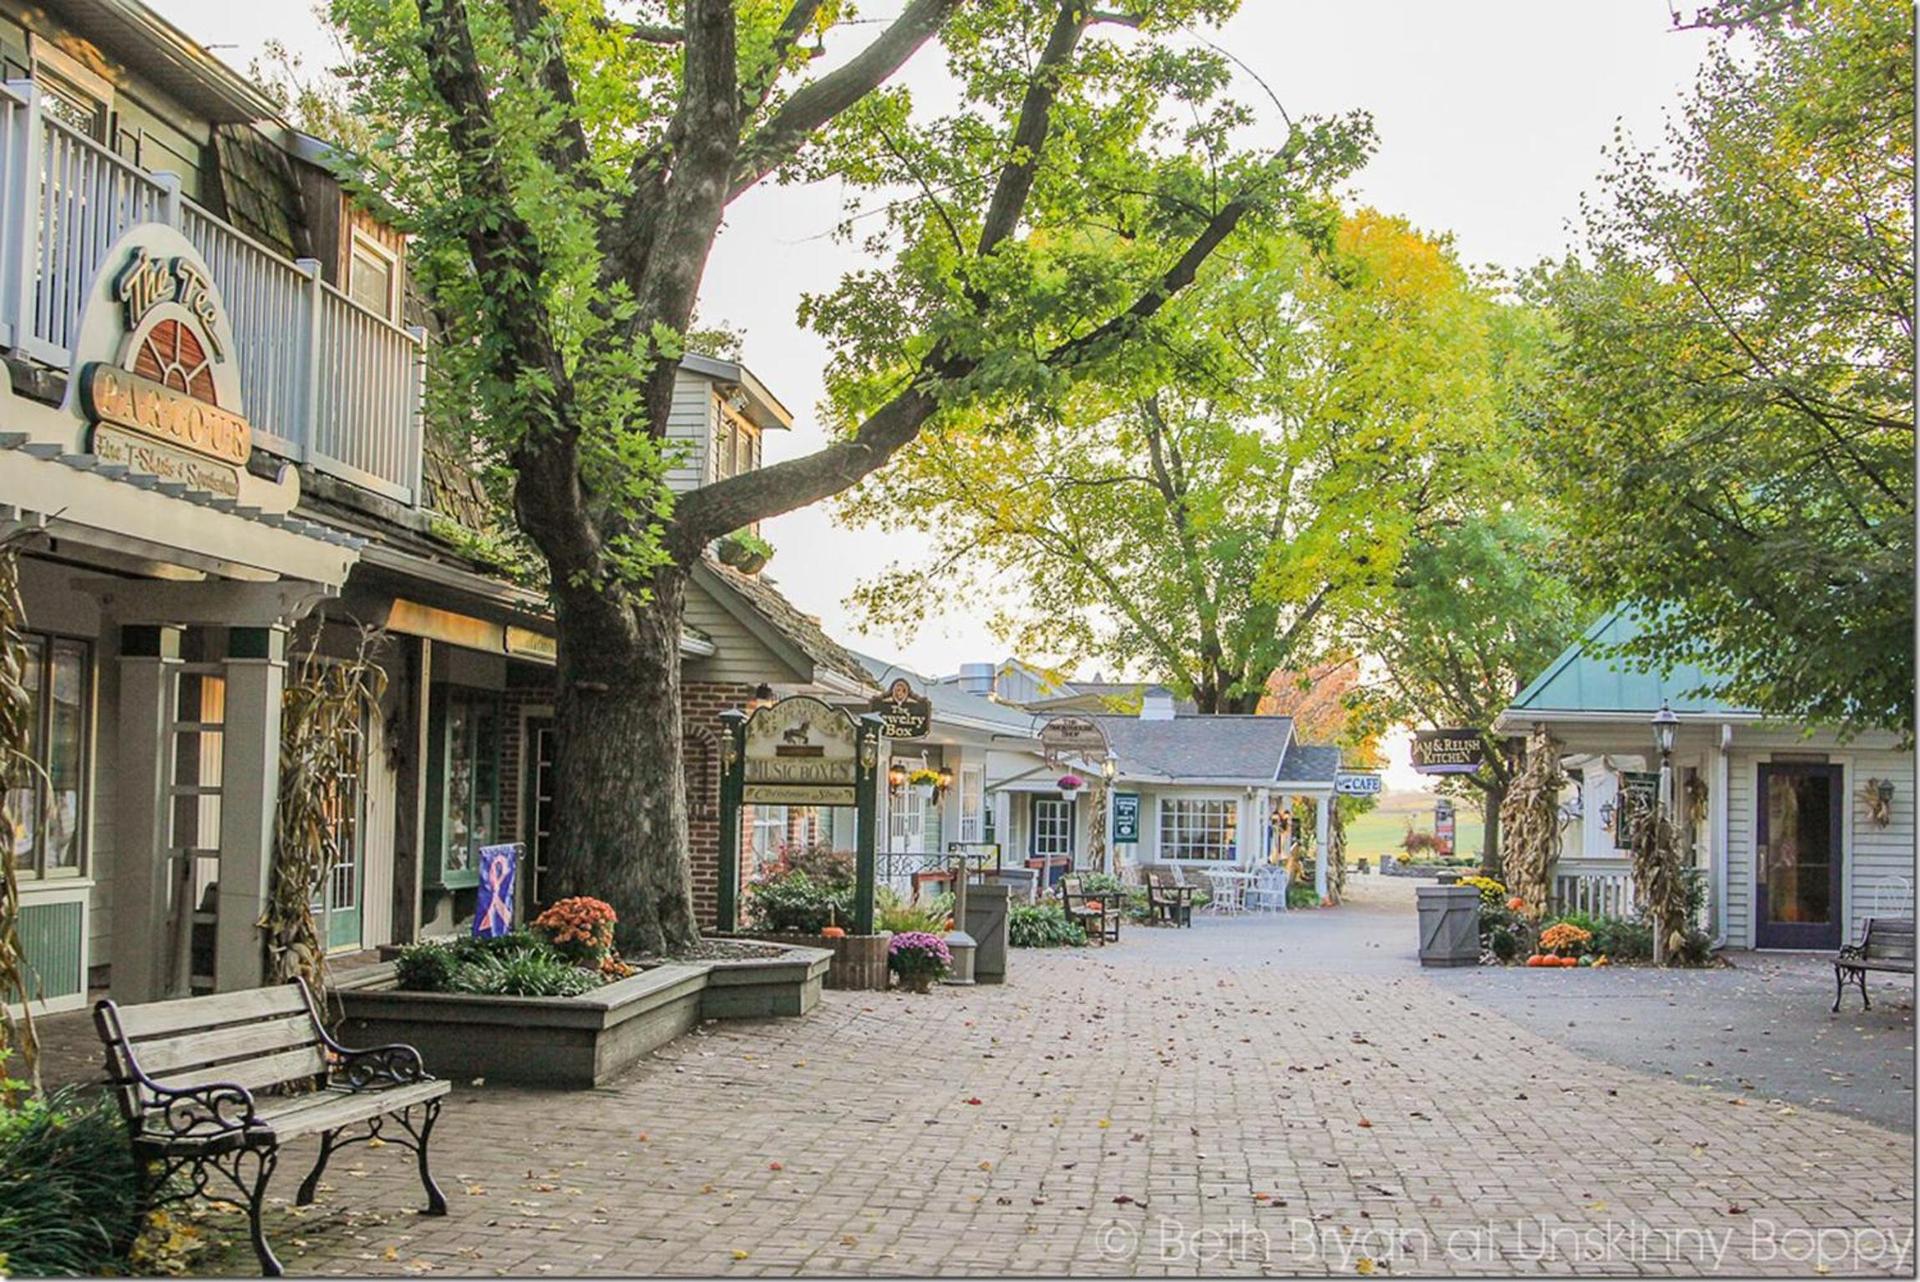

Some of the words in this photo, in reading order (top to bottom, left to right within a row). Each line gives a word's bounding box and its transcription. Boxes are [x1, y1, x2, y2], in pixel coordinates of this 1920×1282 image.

[116, 246, 176, 331] The
[102, 372, 246, 459] PARLOUR
[891, 703, 909, 716] The
[881, 712, 926, 729] welry
[886, 724, 913, 737] Box
[1412, 740, 1433, 756] JAM
[1444, 739, 1480, 753] RELISH
[1423, 750, 1471, 764] KITCHEN
[751, 760, 797, 781] MUSIC
[800, 761, 850, 781] BOXES
